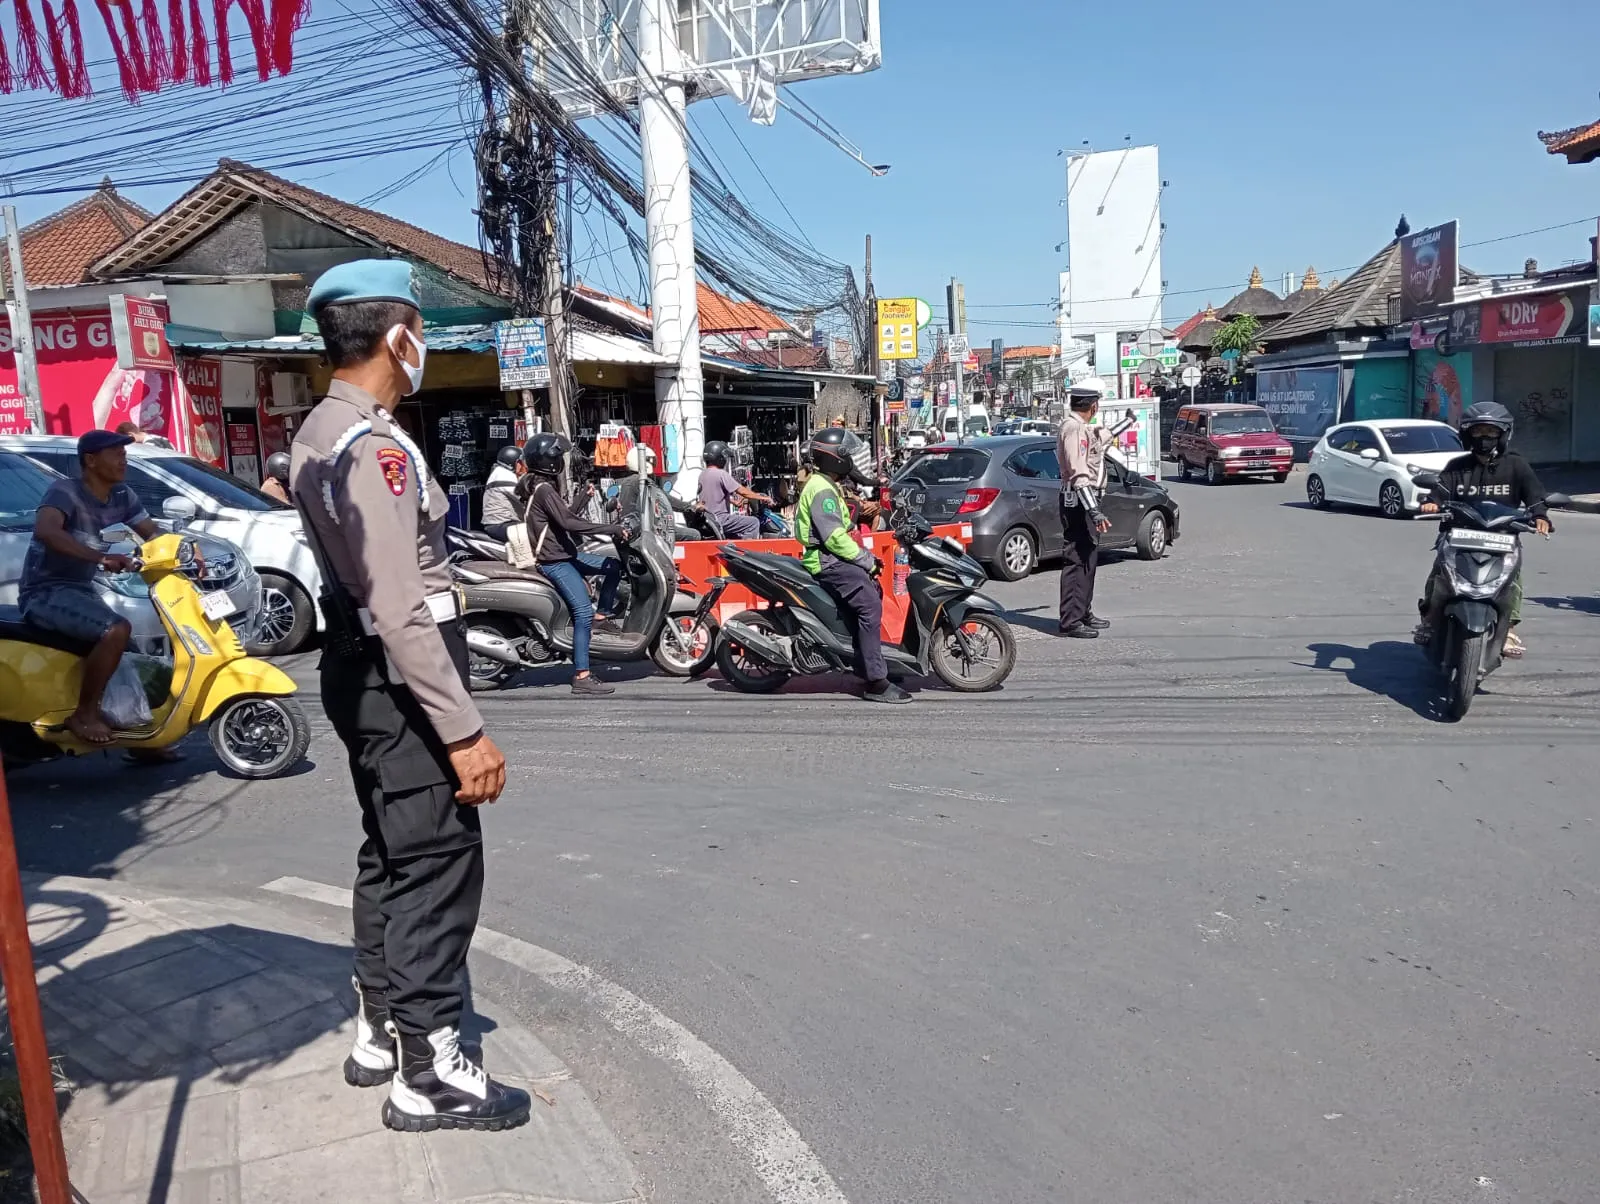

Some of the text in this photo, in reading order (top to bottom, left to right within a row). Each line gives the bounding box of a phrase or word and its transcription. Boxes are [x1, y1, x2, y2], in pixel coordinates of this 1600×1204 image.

[883, 305, 911, 314] Canggu
[881, 312, 912, 320] footwear
[133, 317, 165, 331] AHLI GIGI
[186, 367, 217, 387] AHLI
[193, 395, 218, 416] GIGI
[1456, 484, 1511, 495] COFFEE
